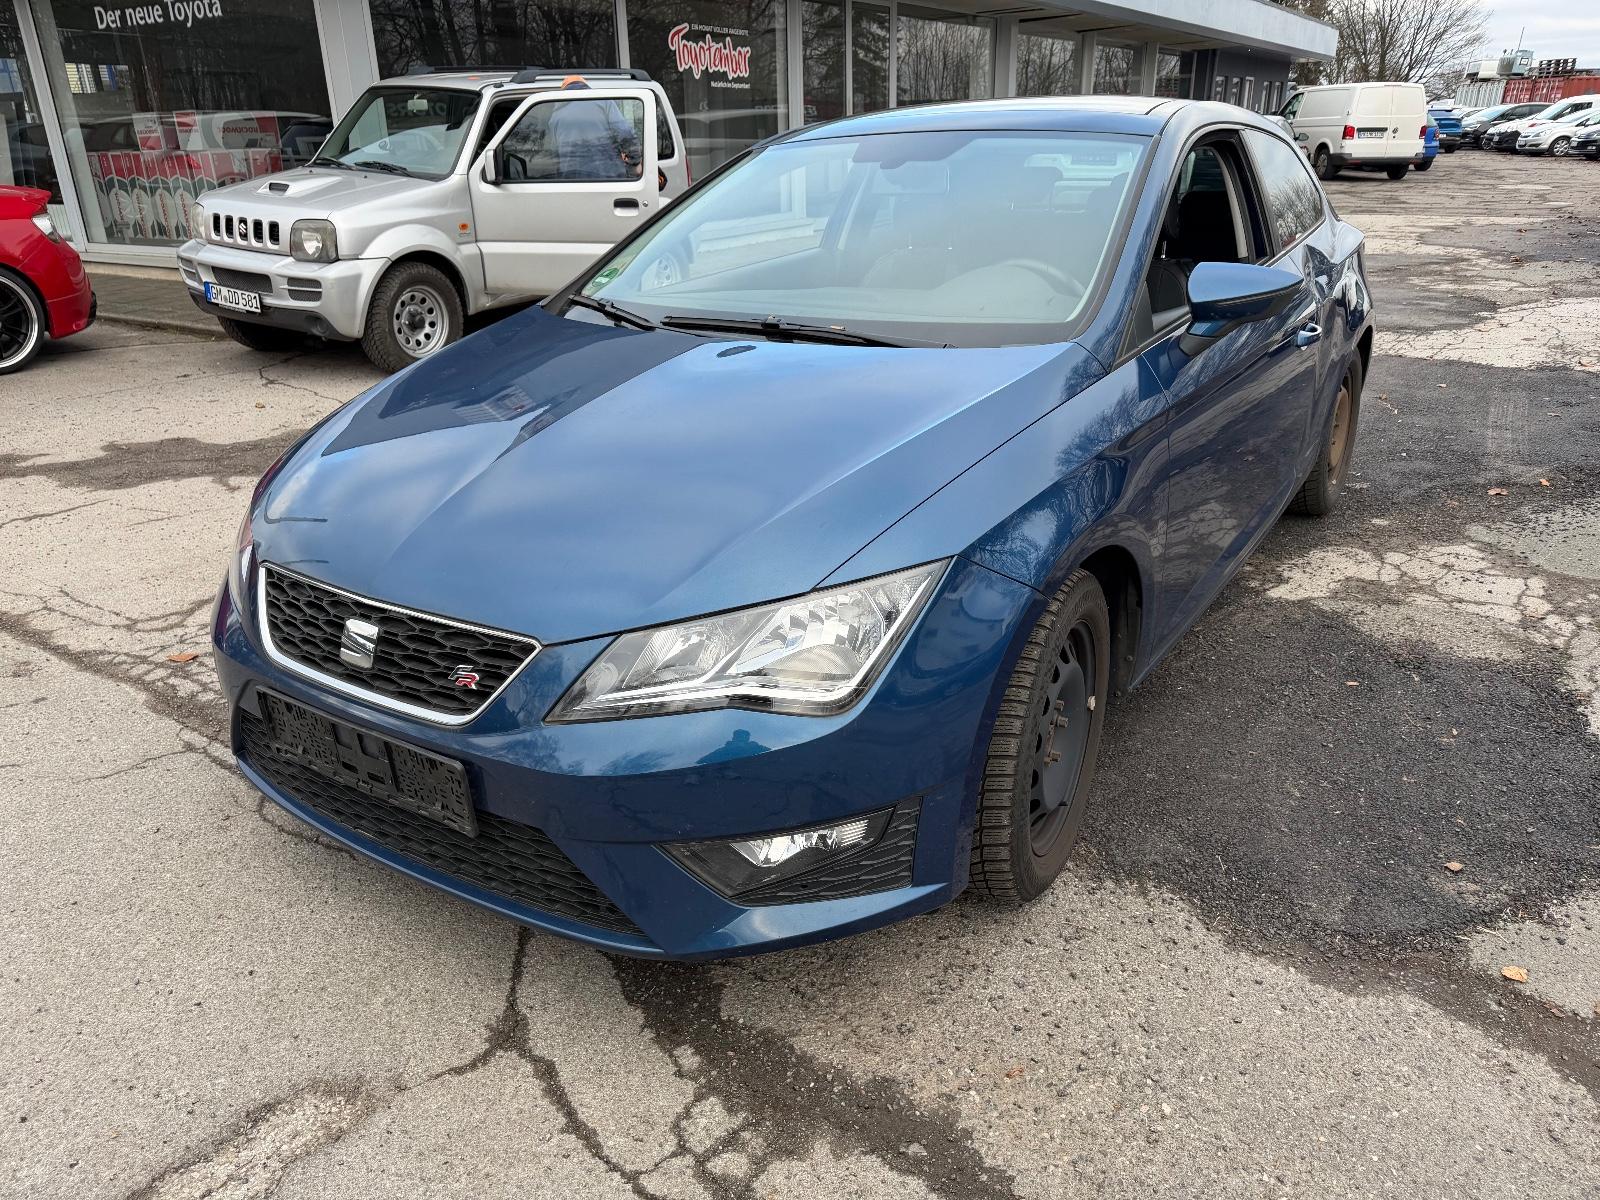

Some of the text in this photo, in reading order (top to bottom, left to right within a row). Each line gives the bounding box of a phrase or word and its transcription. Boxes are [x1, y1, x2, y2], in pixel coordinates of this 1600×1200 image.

[94, 0, 223, 29] Der neue Toyota
[668, 23, 751, 80] Toyotember
[210, 285, 223, 302] GM
[227, 289, 240, 305] DD
[240, 292, 260, 310] 581
